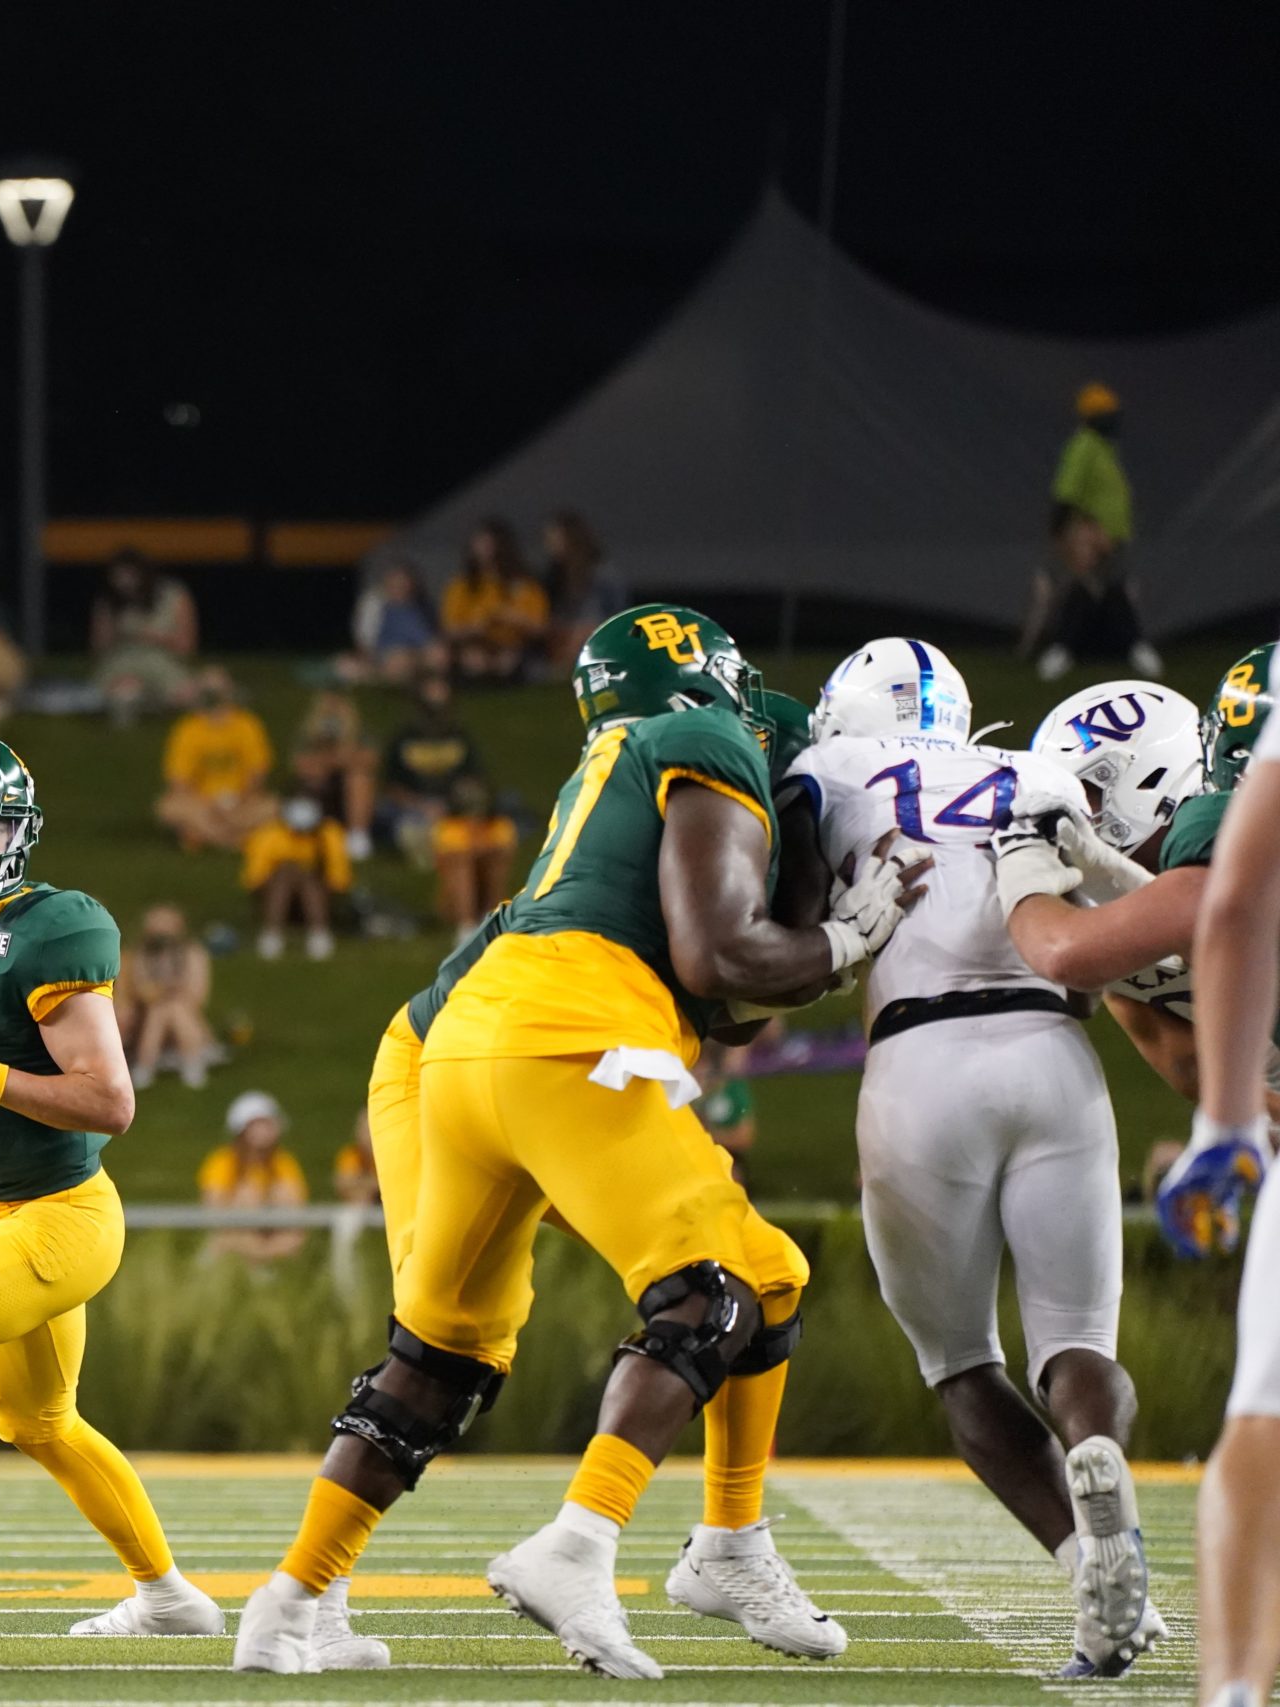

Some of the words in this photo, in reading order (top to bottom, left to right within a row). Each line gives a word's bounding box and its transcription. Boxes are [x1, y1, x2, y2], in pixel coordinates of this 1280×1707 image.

[634, 612, 707, 664] BU
[1065, 693, 1146, 754] KU
[865, 758, 1018, 847] 14
